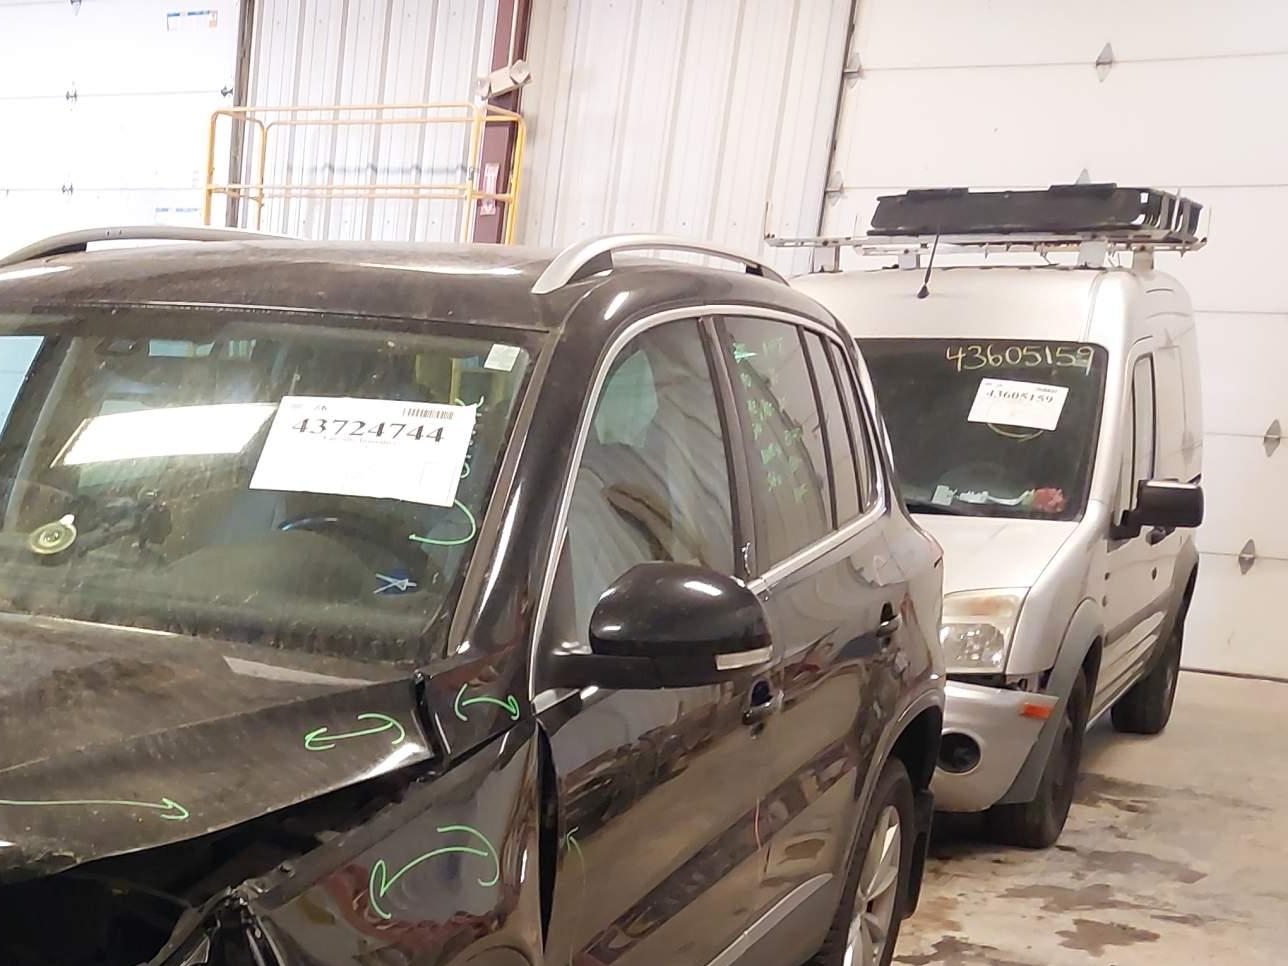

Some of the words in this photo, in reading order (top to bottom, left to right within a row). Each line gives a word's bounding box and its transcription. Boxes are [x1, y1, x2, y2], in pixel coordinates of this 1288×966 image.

[945, 344, 1095, 376] 43605159
[985, 389, 1054, 404] 43605159
[291, 418, 445, 443] 43724744
